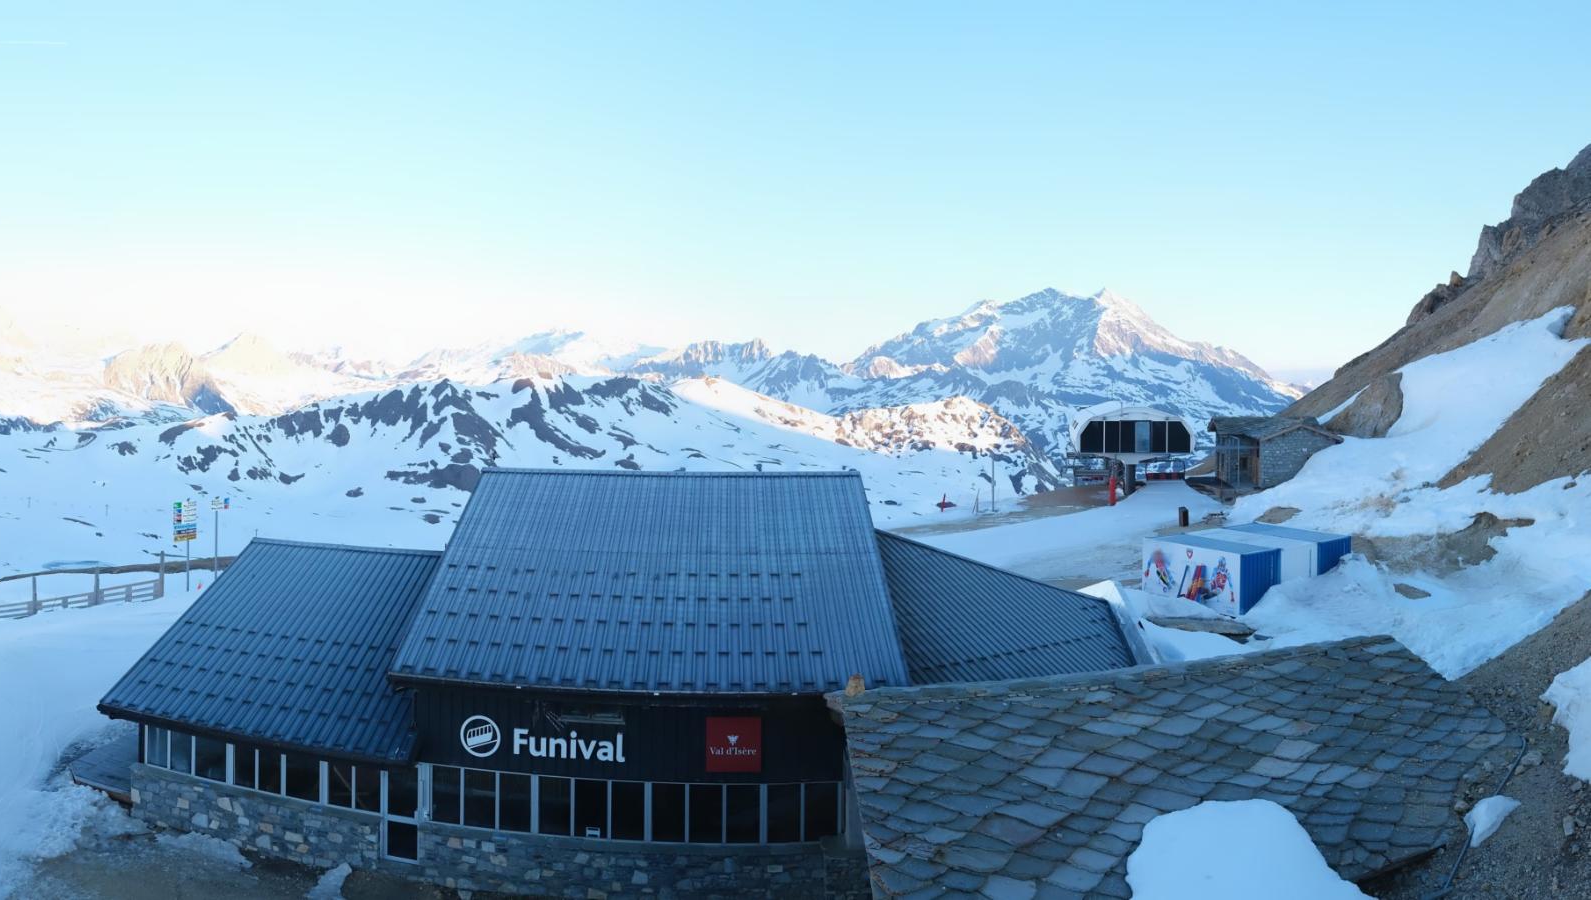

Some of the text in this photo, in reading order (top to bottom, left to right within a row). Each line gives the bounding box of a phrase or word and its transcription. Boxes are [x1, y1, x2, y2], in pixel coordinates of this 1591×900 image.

[513, 727, 626, 763] Funival
[709, 745, 757, 756] Val d'Isère
